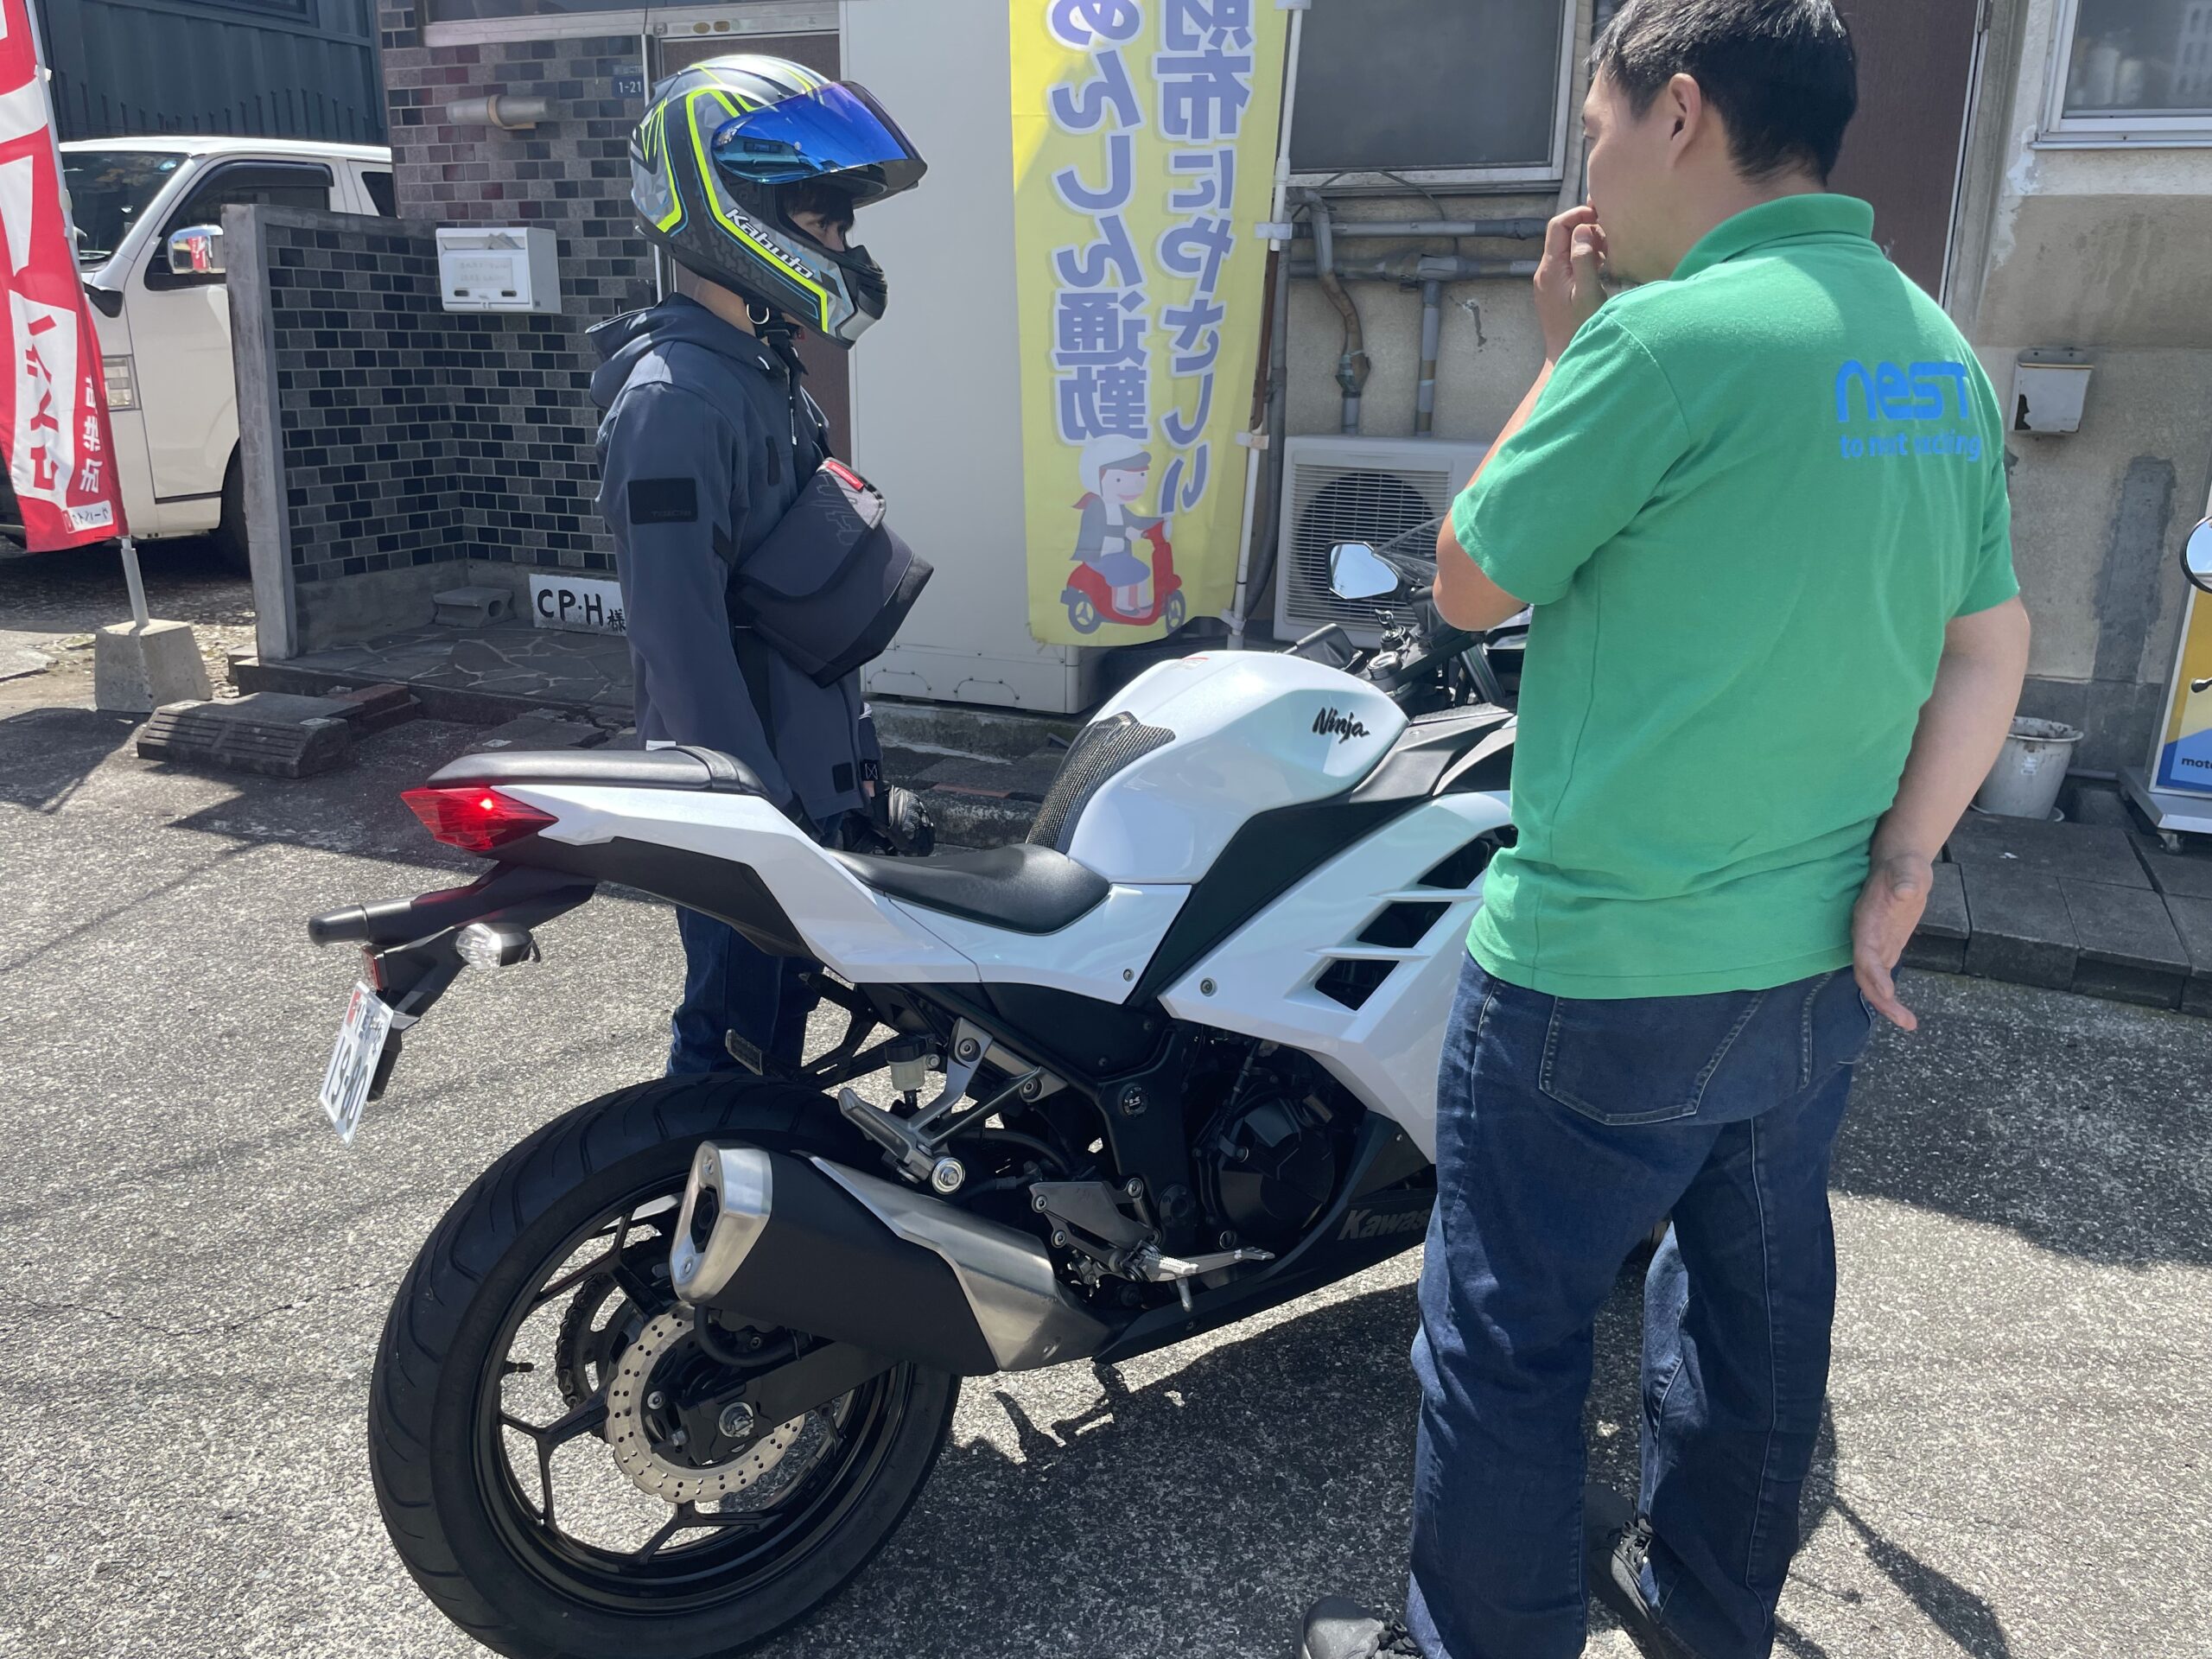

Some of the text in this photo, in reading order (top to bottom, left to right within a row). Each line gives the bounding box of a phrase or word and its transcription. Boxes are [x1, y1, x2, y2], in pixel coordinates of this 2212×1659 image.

[619, 81, 642, 93] 1-21
[725, 208, 814, 279] Kabuto
[1312, 707, 1370, 744] Ninja
[2181, 757, 2212, 769] mot
[1337, 1209, 1432, 1241] Kawas
